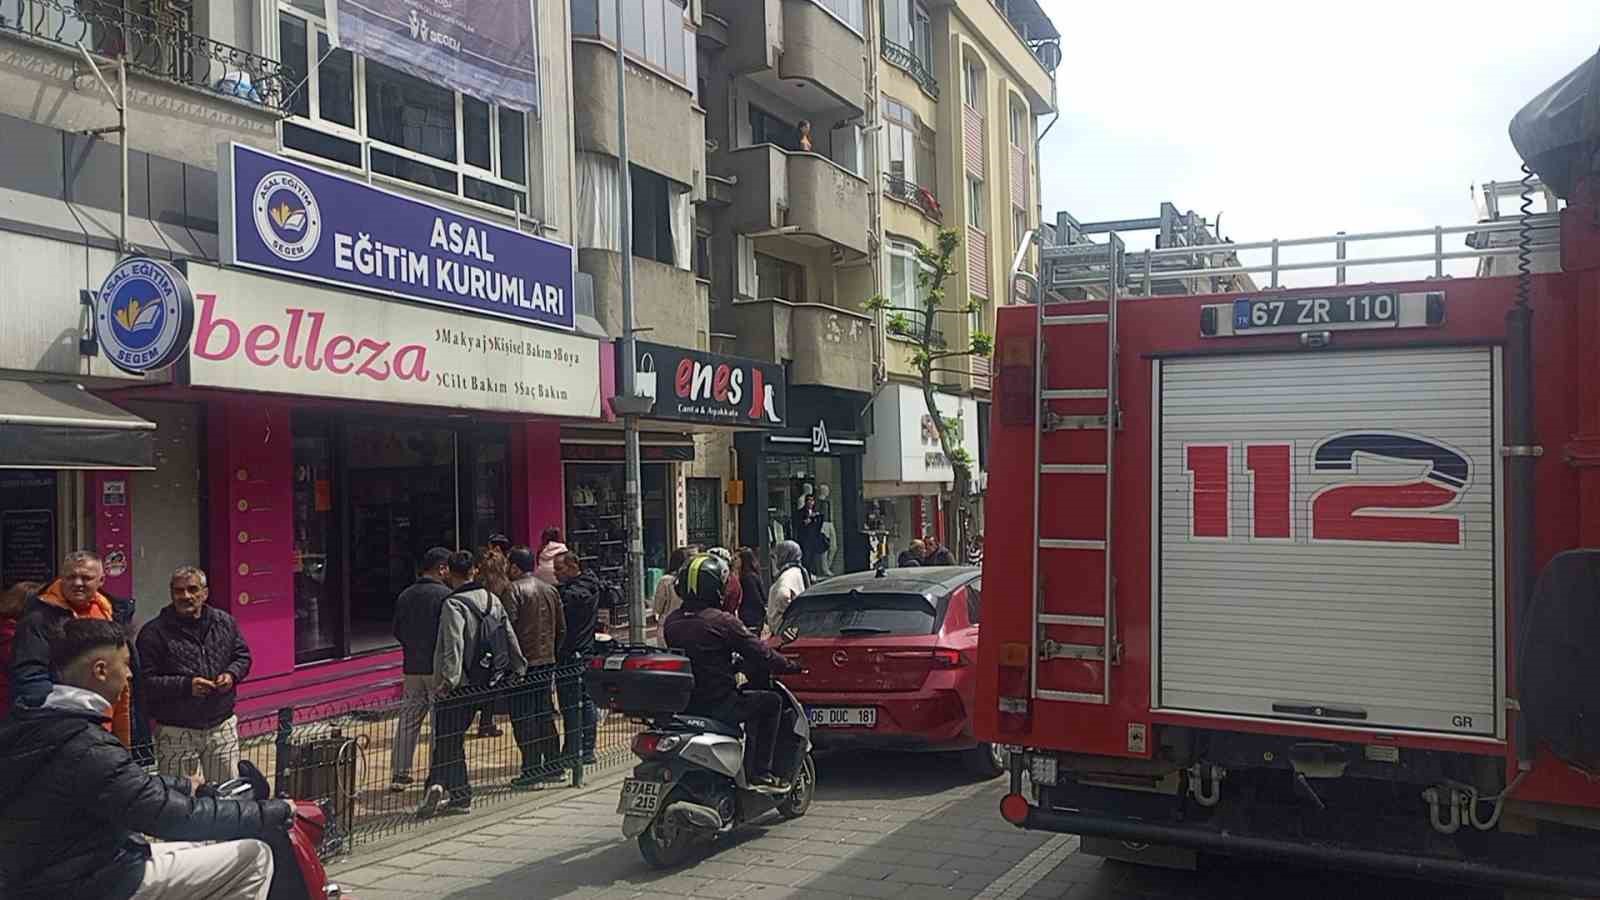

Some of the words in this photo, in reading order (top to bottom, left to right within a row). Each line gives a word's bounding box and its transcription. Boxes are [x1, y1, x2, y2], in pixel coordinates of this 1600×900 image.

[272, 240, 305, 255] SEGEM
[429, 216, 495, 263] ASAL
[102, 269, 130, 302] ASAL
[334, 231, 430, 288] EĞİTİM
[435, 257, 565, 316] KURUMLARI
[1252, 301, 1285, 326] 67
[1297, 299, 1331, 324] ZR
[1347, 295, 1393, 321] 110
[193, 293, 430, 382] belleza
[441, 328, 487, 353] Makyaj
[526, 342, 552, 360] Bakım
[557, 347, 580, 367] Boya
[116, 347, 161, 364] SEGEM
[442, 372, 468, 390] Cilt
[471, 375, 507, 393] Bakım
[519, 381, 536, 398] Saç
[538, 384, 568, 400] Bakım
[675, 358, 743, 405] enes
[1183, 429, 1473, 549] 112
[811, 709, 824, 723] 06
[829, 709, 849, 723] DUC
[859, 709, 875, 723] 181
[1451, 714, 1473, 729] GR
[635, 796, 656, 809] 215
